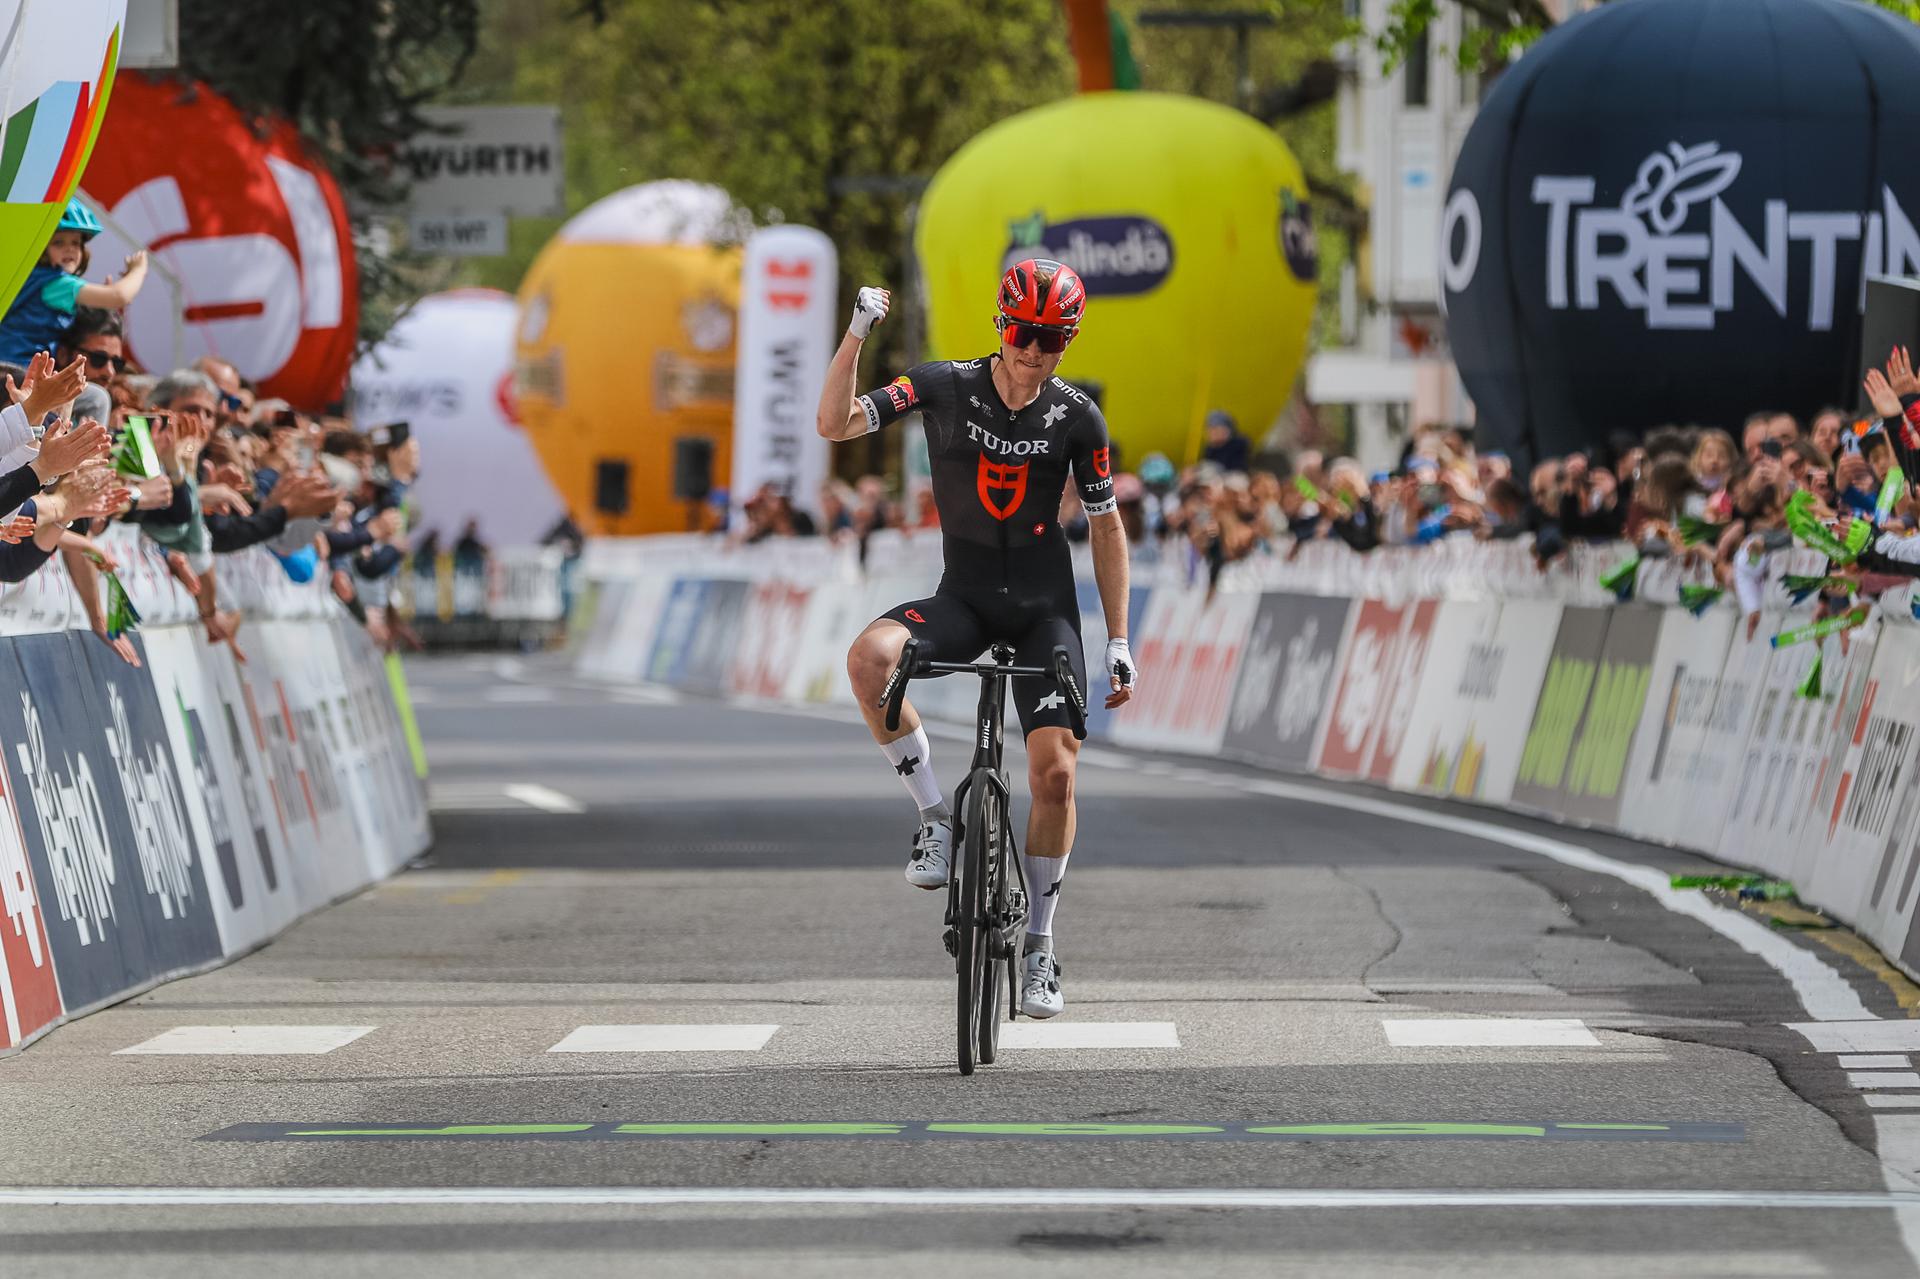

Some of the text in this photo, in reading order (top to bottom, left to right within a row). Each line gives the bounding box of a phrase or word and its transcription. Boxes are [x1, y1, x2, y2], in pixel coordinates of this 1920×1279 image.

[1007, 275, 1020, 297] TUDOR
[1063, 287, 1082, 307] TUDOR
[951, 358, 983, 371] BMC
[883, 385, 907, 412] Bull
[1051, 376, 1089, 405] BMC
[966, 420, 1049, 456] TUDOR
[880, 668, 901, 700] SRAM
[1067, 675, 1084, 707] SRAM
[980, 718, 991, 750] BMC
[1844, 714, 1915, 838] WÜRTH
[16, 742, 118, 947] TRENTINO
